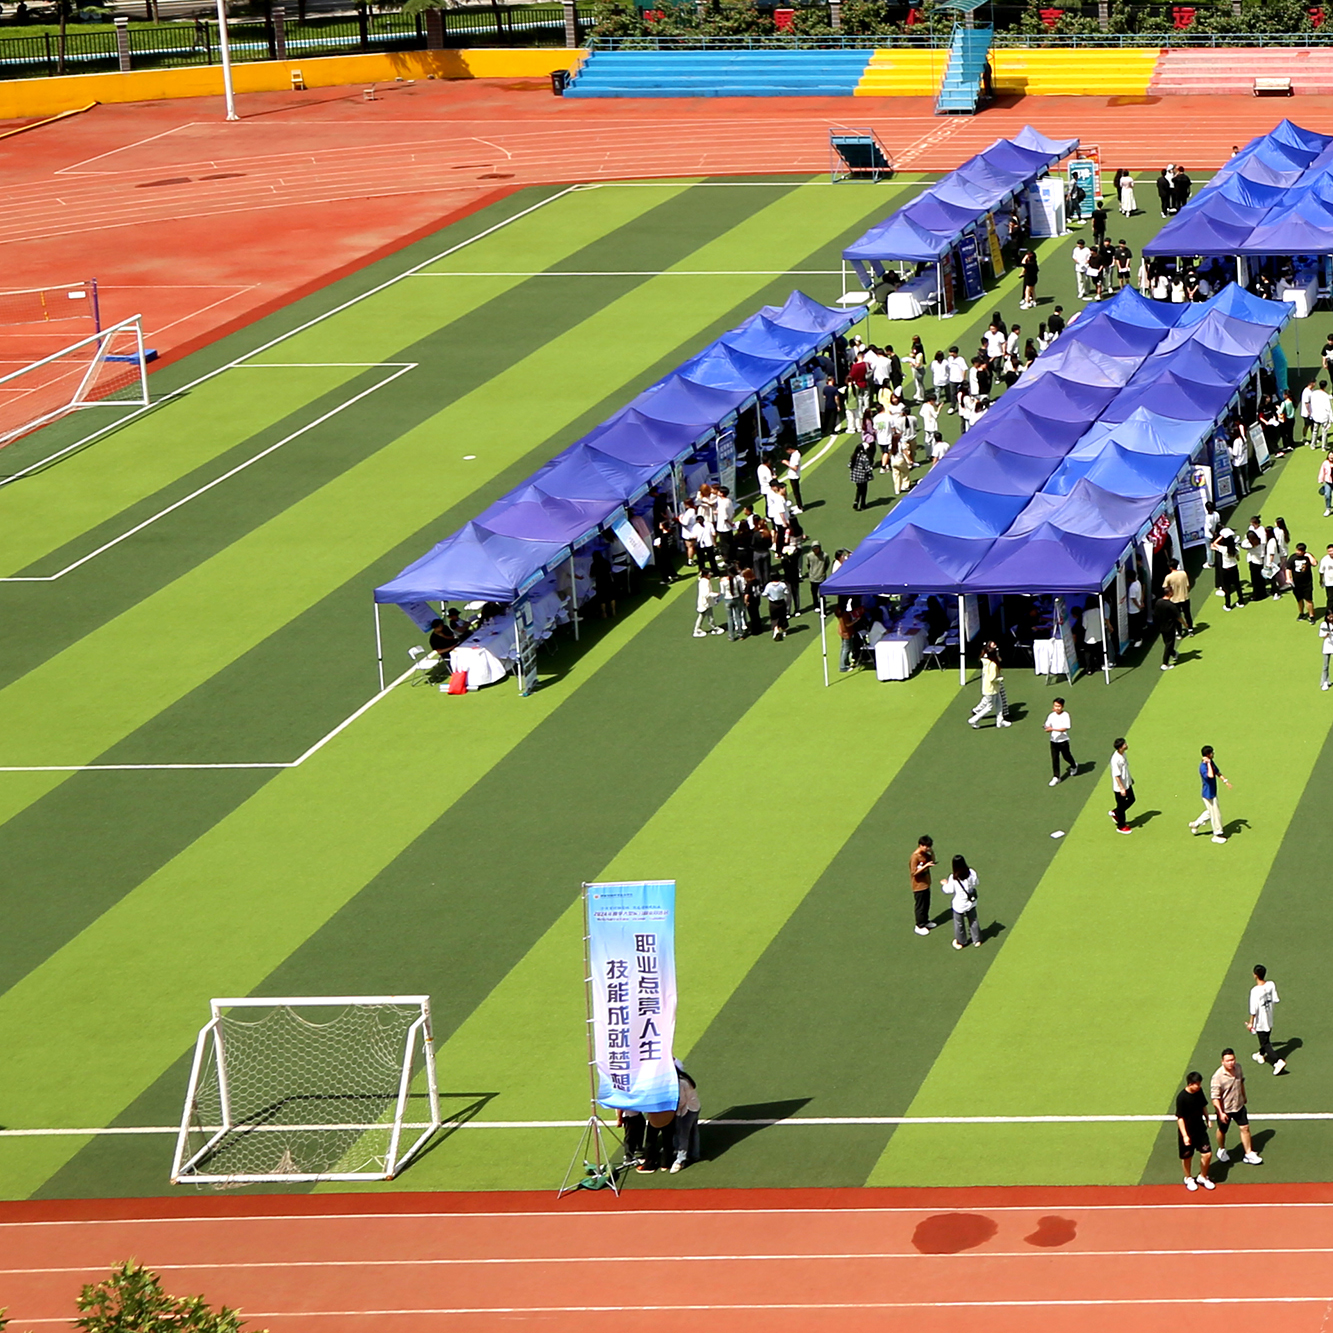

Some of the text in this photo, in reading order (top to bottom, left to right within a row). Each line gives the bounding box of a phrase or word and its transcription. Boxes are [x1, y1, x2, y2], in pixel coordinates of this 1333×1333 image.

[606, 959, 632, 1093] 技能成就梦想
[635, 933, 662, 1062] 职业点亮人生
